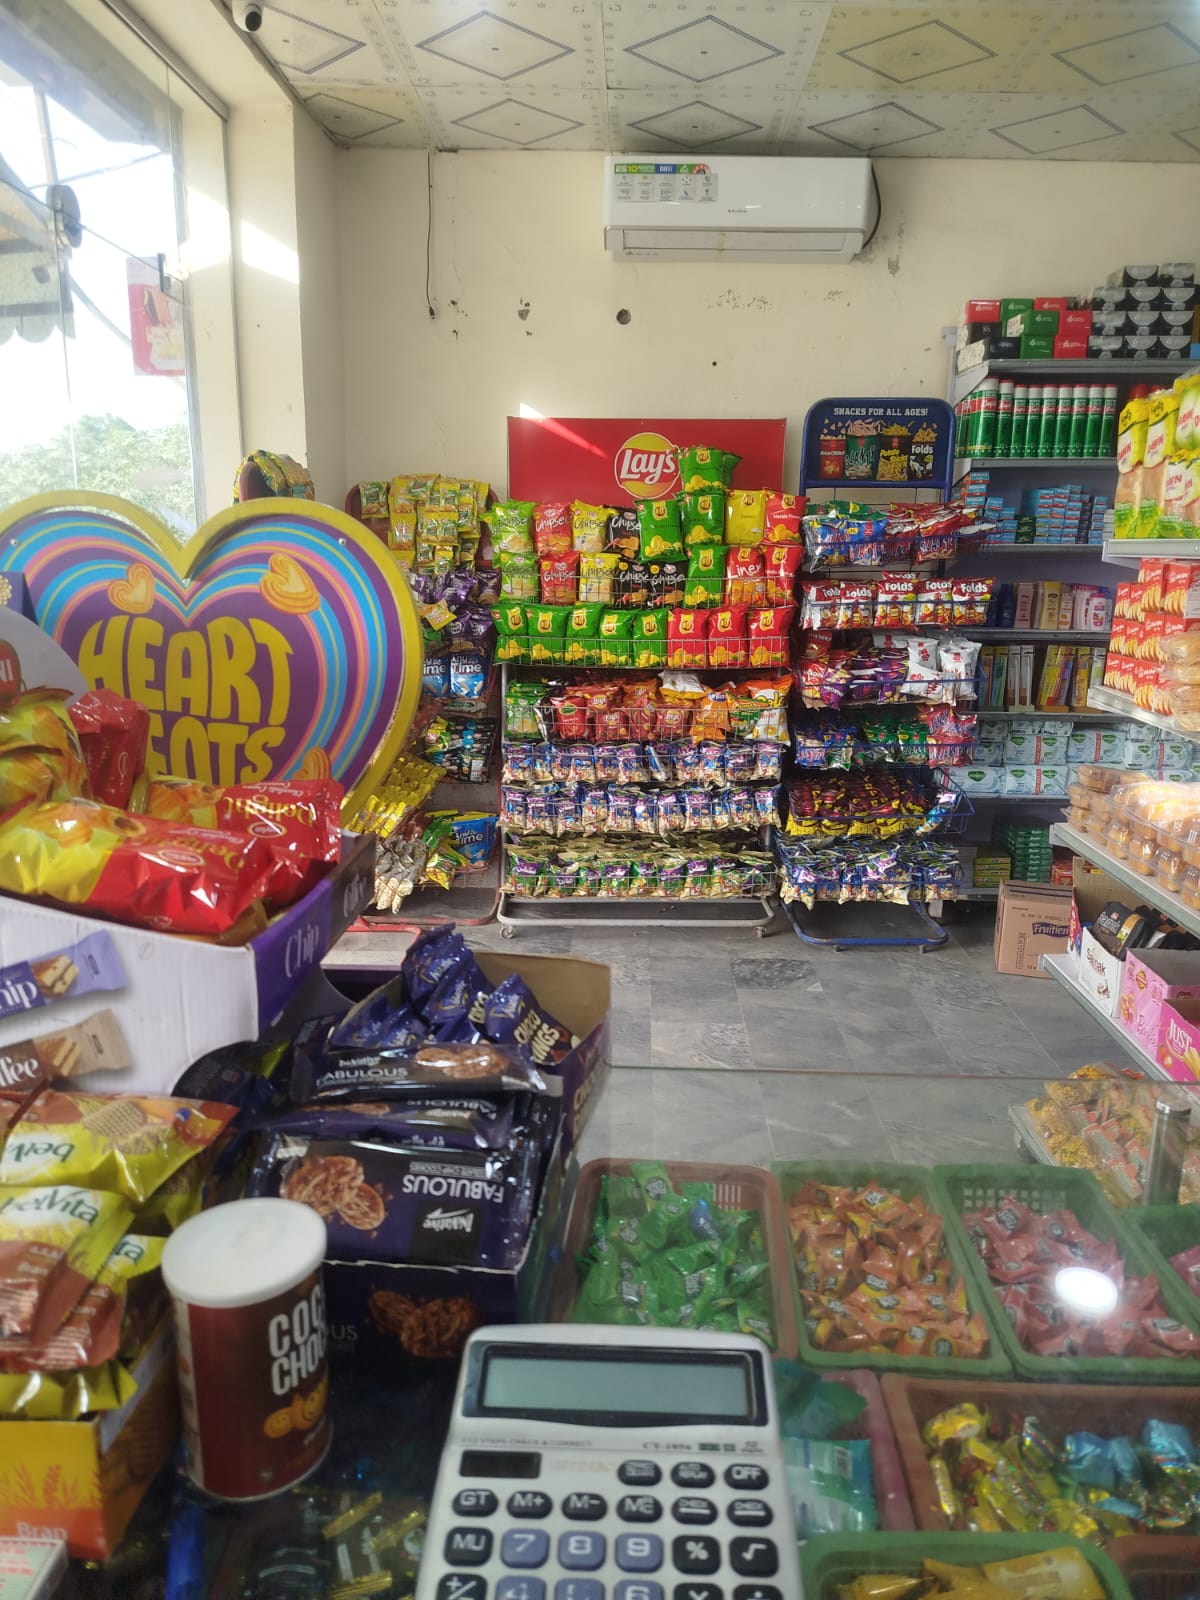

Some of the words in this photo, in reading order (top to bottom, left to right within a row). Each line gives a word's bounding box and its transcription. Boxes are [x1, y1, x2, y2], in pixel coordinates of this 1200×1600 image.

[834, 407, 866, 416] SNACKS
[868, 408, 884, 416] FOR
[886, 408, 902, 416] ALL
[904, 408, 929, 416] AGES!
[911, 445, 934, 454] Folds
[620, 448, 676, 485] Lay's
[885, 581, 913, 592] Folds
[960, 582, 988, 593] Folds
[78, 615, 294, 726] HEART
[423, 665, 447, 674] ime
[0, 980, 38, 1009] ip
[1168, 1018, 1193, 1054] JUST
[0, 1056, 39, 1087] ffee
[402, 1174, 505, 1204] FABULOUS
[268, 1284, 323, 1358] COC
[731, 1466, 761, 1480] OFF
[459, 1490, 491, 1506] GT
[513, 1493, 545, 1507] M+
[453, 1533, 486, 1551] MU
[512, 1533, 536, 1552] 7
[567, 1535, 593, 1555] 8
[626, 1537, 651, 1557] 9
[685, 1540, 709, 1560] %
